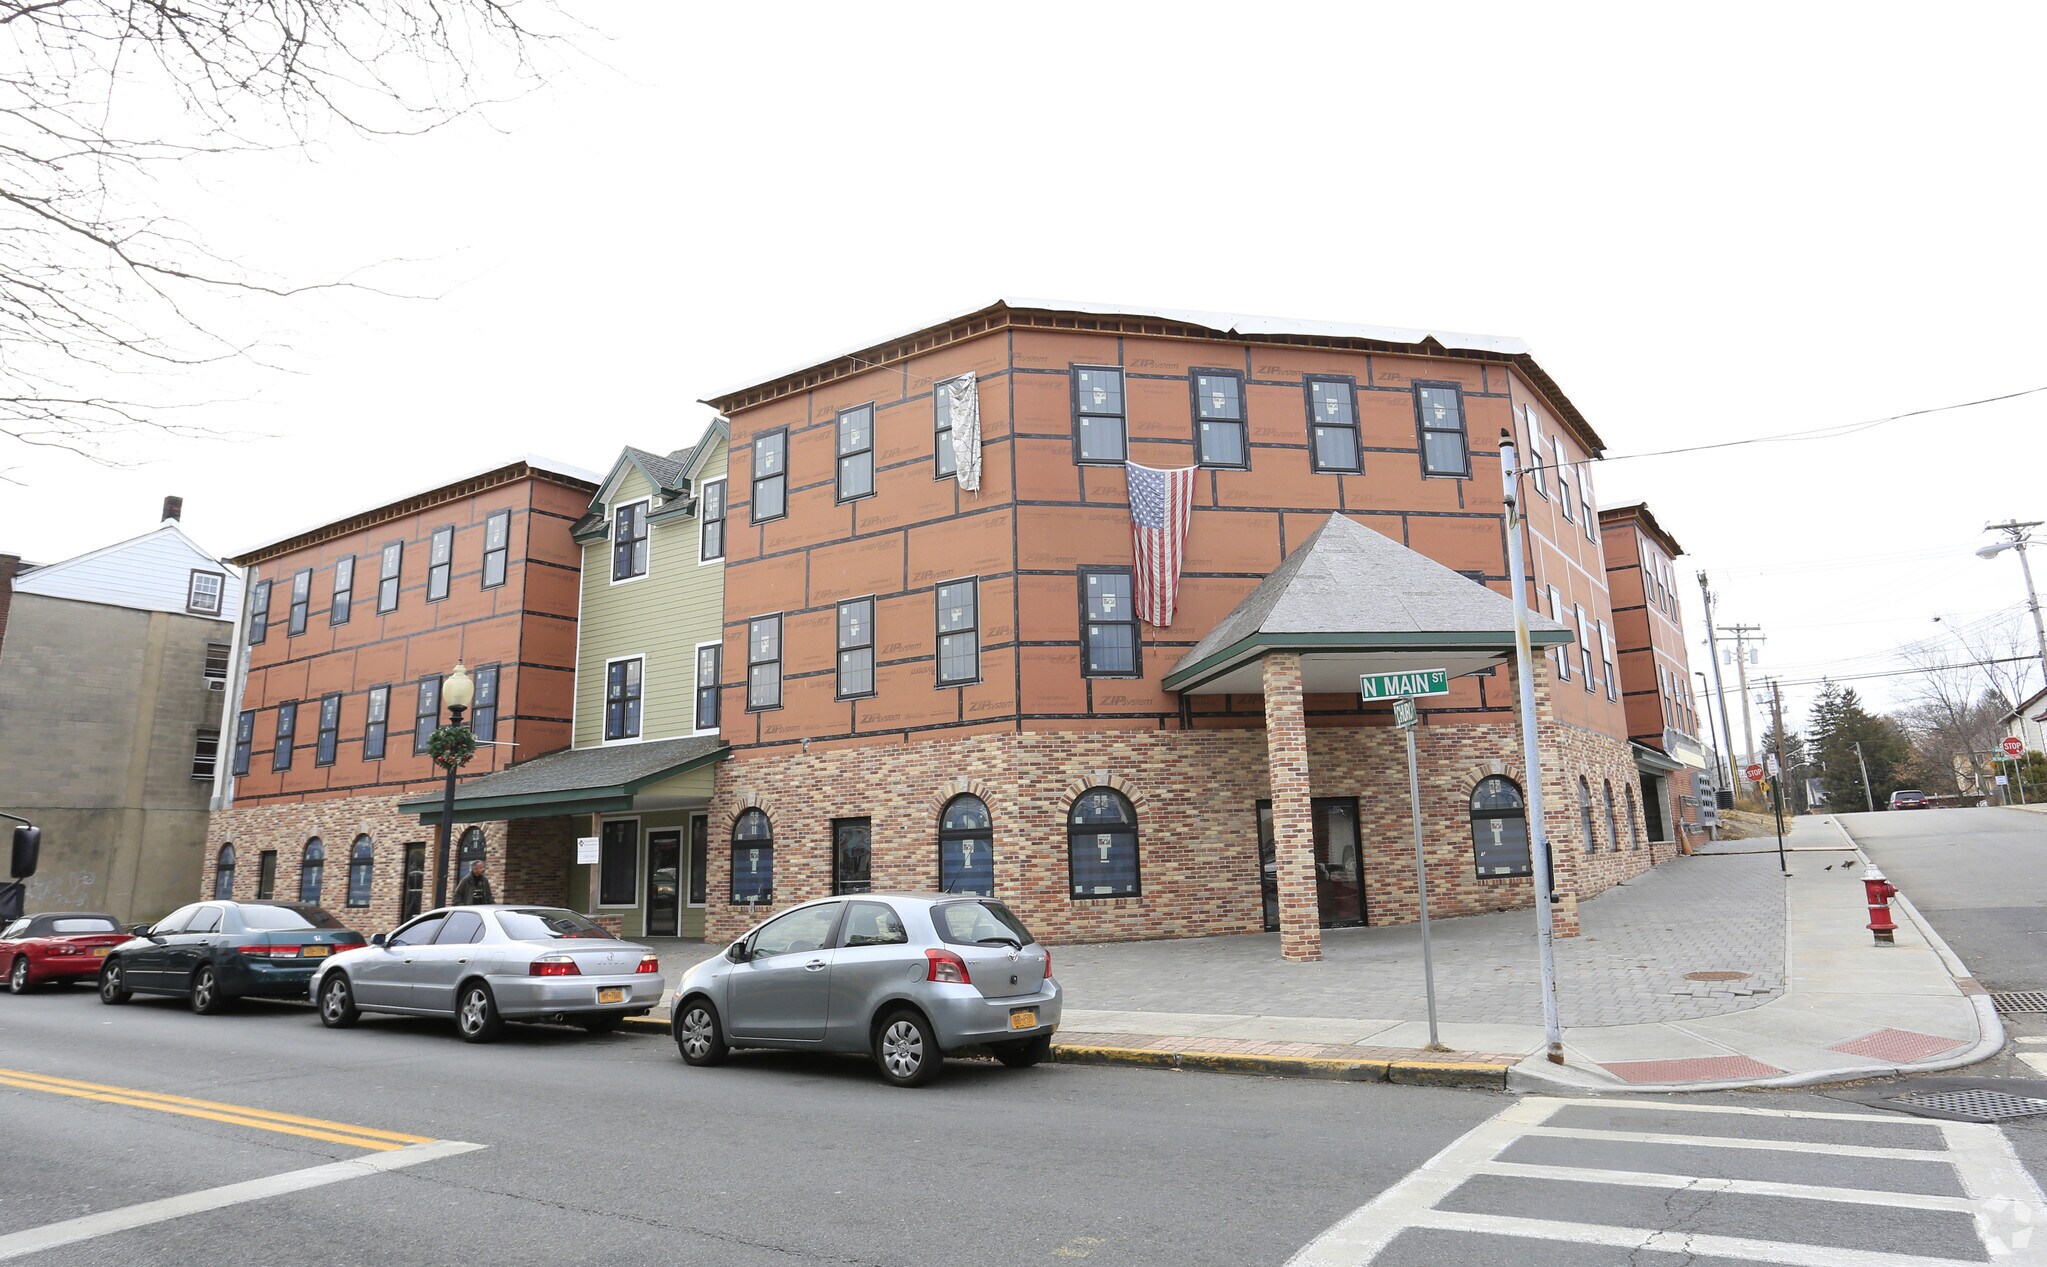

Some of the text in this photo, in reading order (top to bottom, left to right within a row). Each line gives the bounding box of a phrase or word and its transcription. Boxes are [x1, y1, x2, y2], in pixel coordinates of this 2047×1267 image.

[1363, 672, 1444, 698] N MAIN ST
[1099, 695, 1153, 708] ZIPsystem
[2003, 742, 2021, 750] STOP
[1746, 768, 1763, 778] STOP
